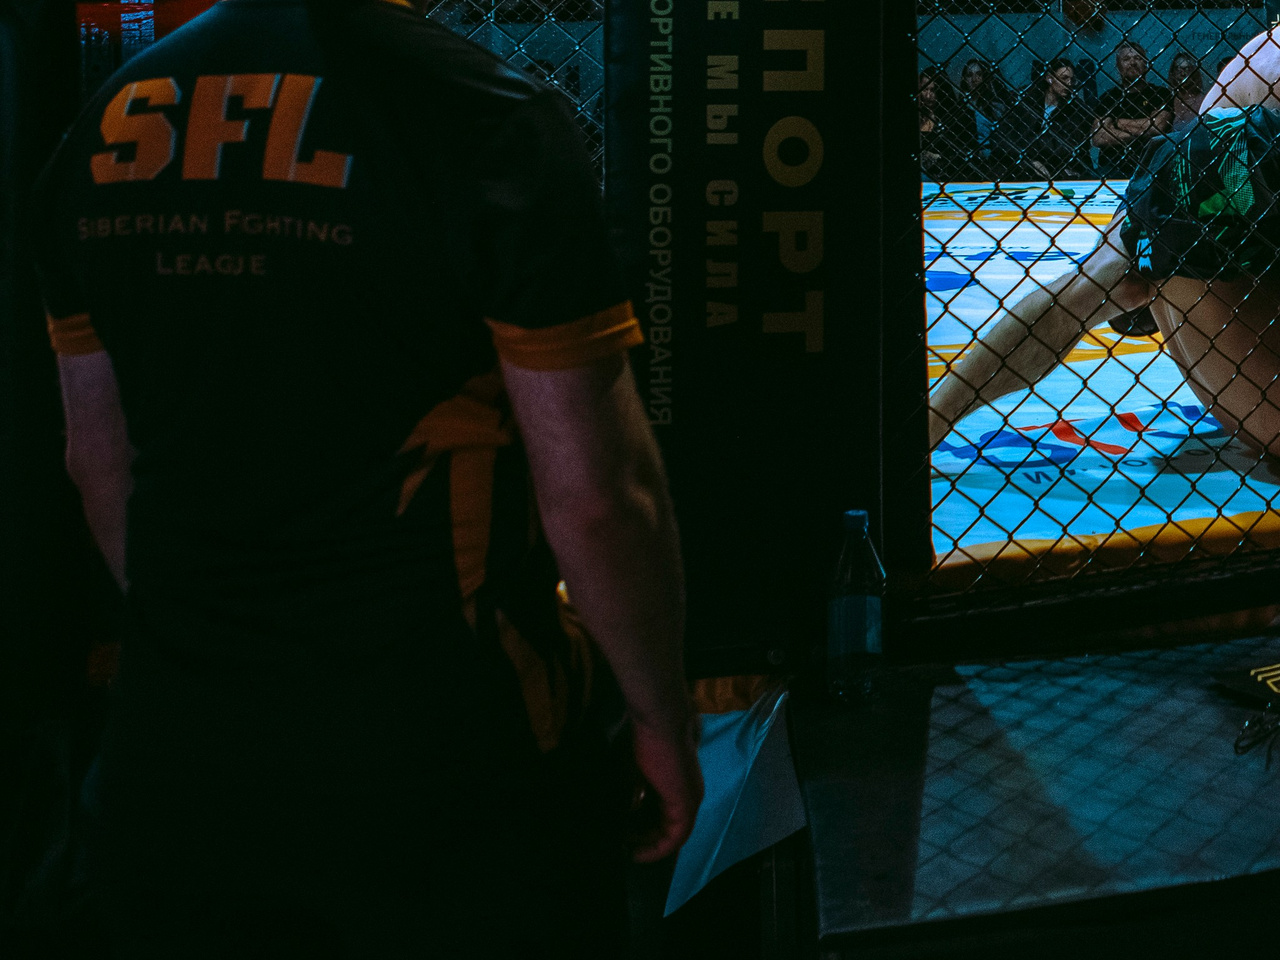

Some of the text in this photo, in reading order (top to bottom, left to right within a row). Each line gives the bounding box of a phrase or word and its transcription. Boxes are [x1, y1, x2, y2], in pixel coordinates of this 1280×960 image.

[89, 72, 353, 188] SFL
[704, 53, 740, 146] МЫ
[223, 209, 354, 246] FGHTING
[704, 178, 739, 328] СИЛА
[645, 182, 673, 426] ОБОРУДОВАНИЯ
